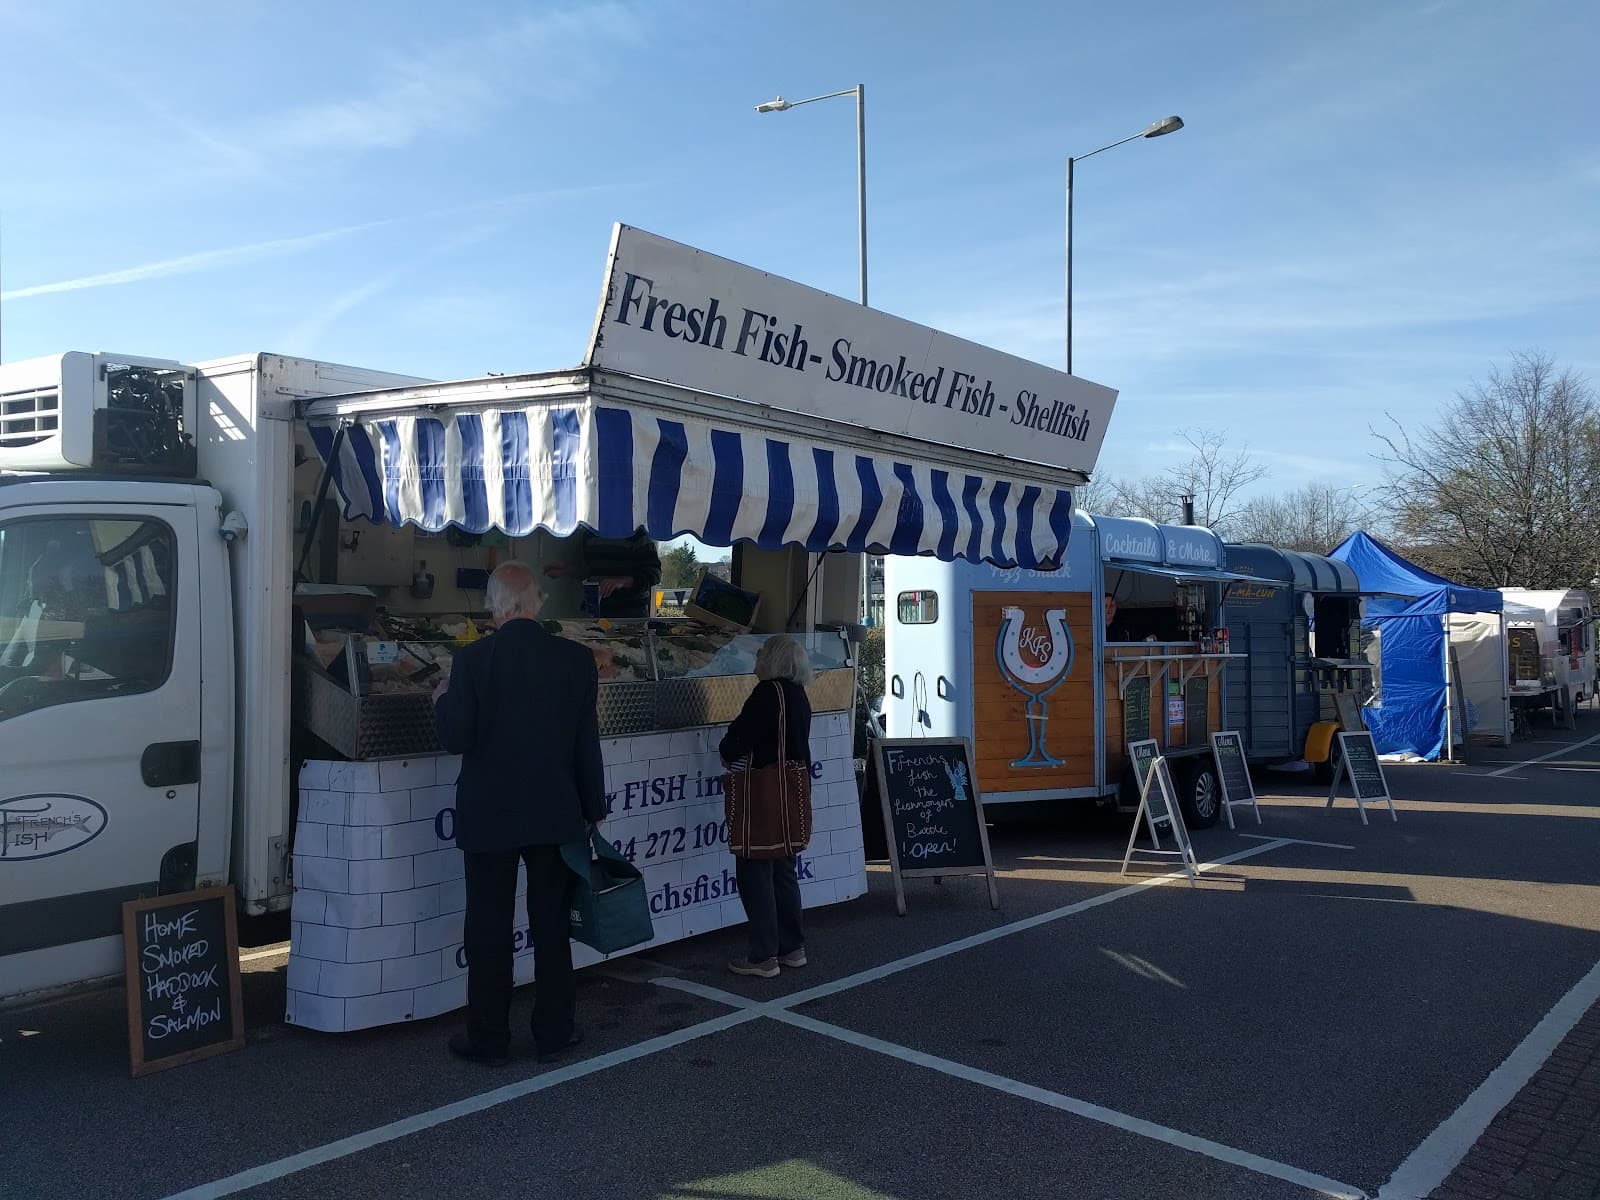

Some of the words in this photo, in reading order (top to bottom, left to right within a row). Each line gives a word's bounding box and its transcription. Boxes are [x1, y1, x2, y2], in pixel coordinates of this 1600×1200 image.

[614, 271, 727, 350] Fresh
[825, 338, 944, 405] Smoked
[943, 370, 995, 418] Fish
[1010, 389, 1091, 442] Shellfish
[1105, 533, 1157, 557] Cocktails
[1168, 540, 1177, 558] &
[623, 774, 688, 811] FISH
[645, 827, 686, 859] 272
[148, 997, 221, 1039] SALMON
[172, 993, 188, 1014] &
